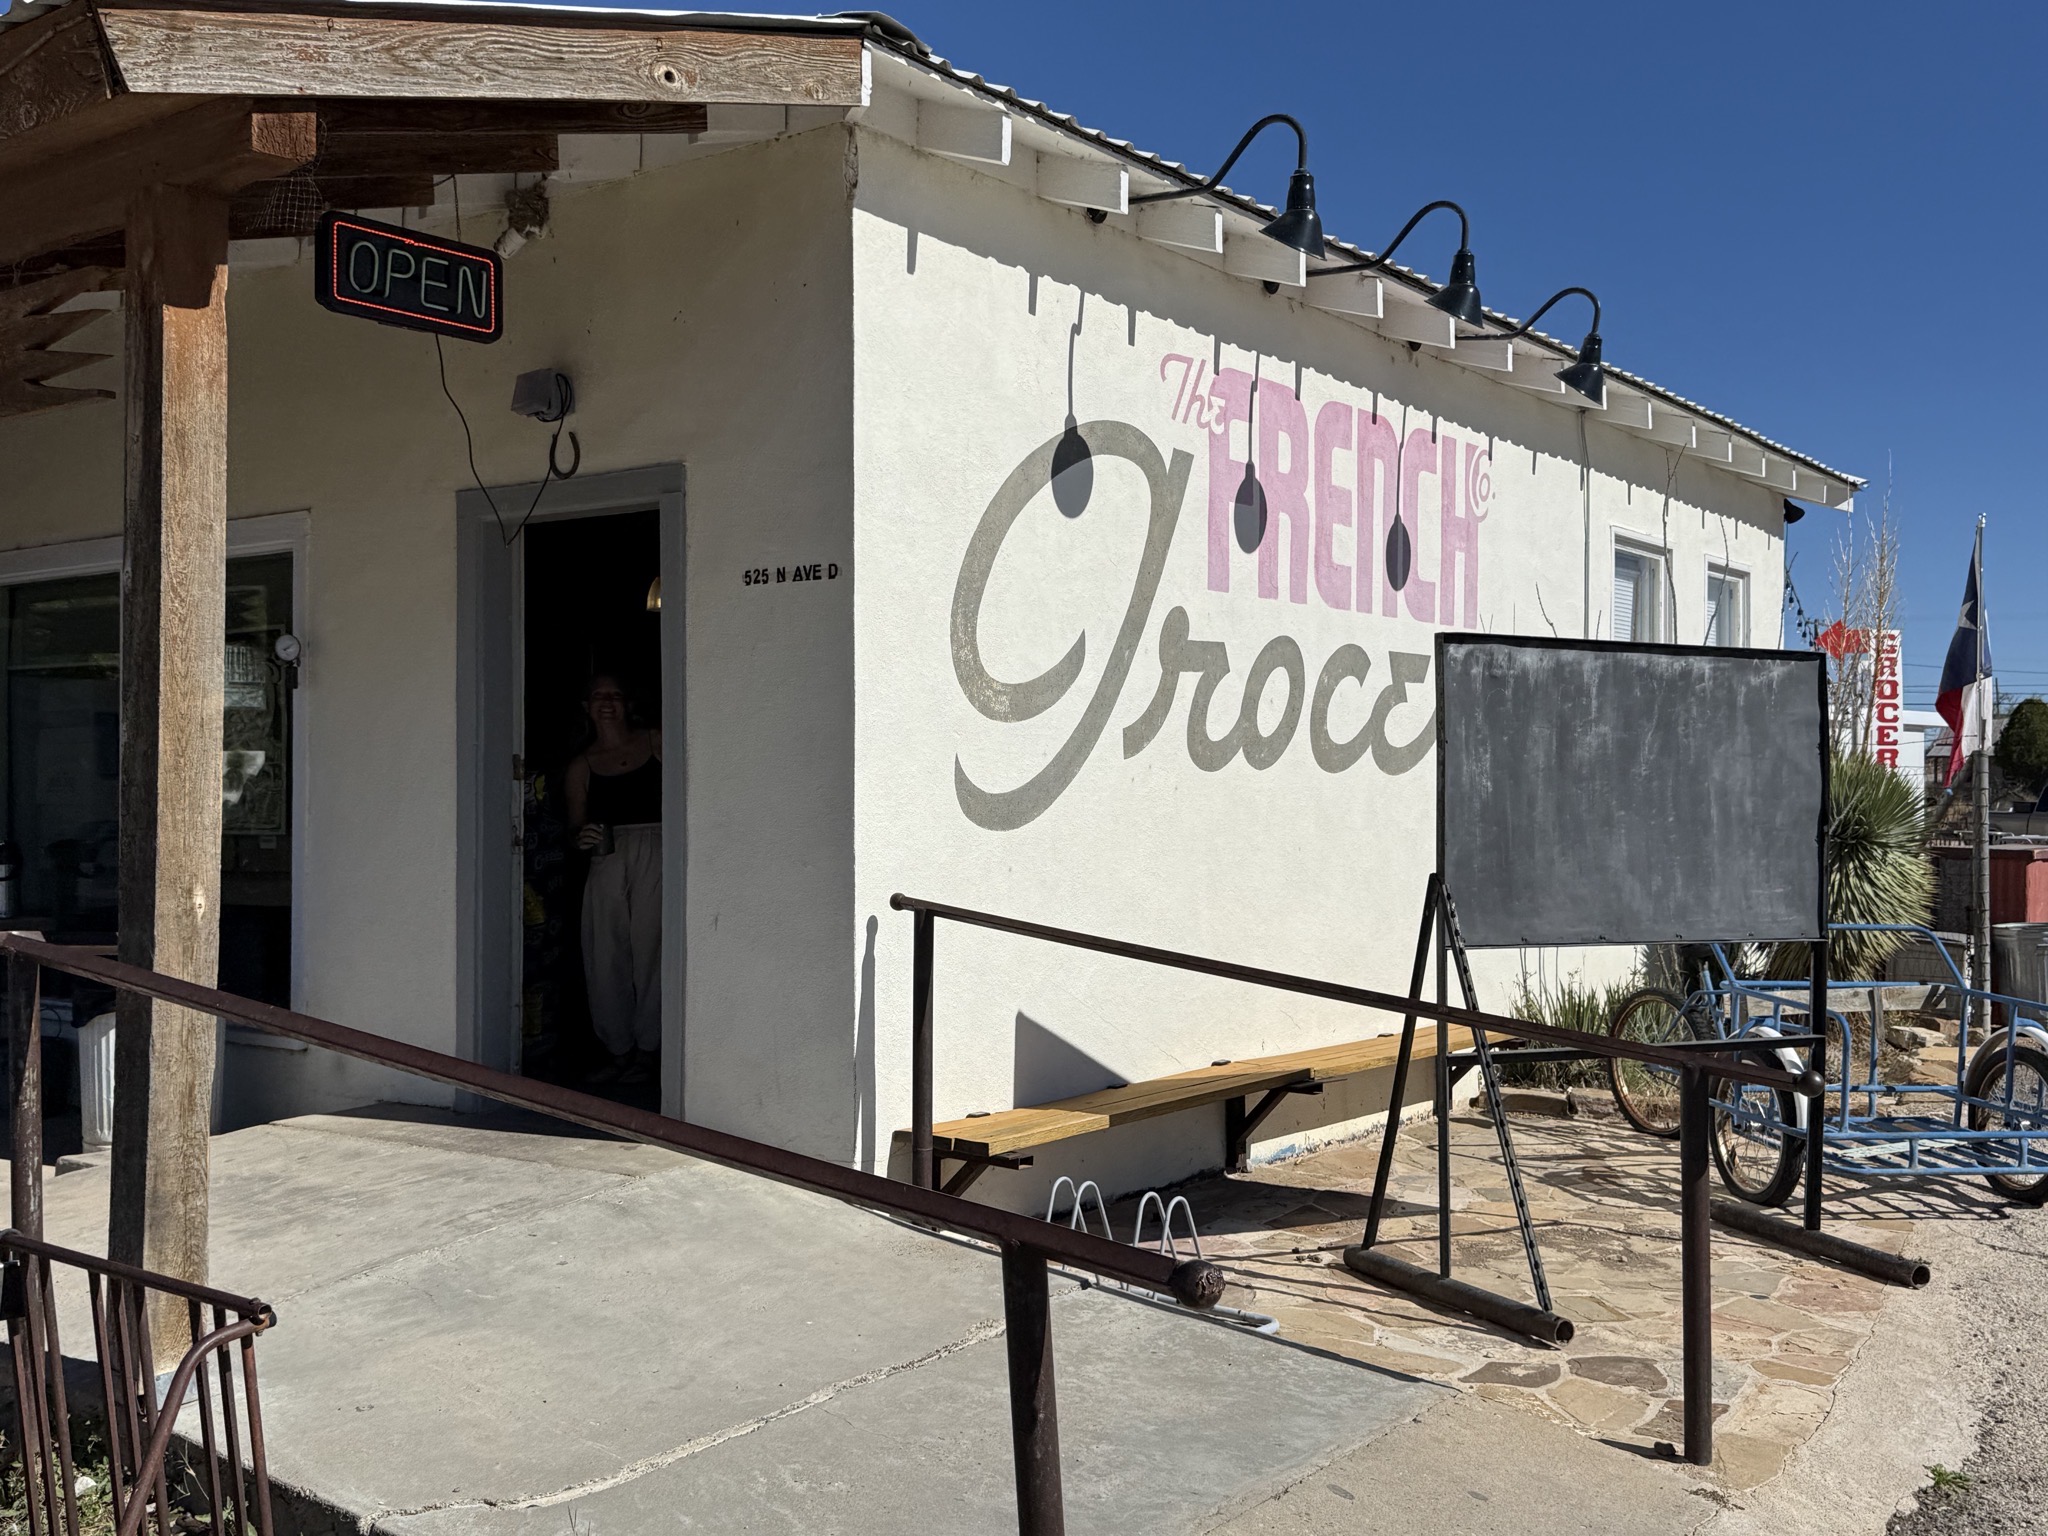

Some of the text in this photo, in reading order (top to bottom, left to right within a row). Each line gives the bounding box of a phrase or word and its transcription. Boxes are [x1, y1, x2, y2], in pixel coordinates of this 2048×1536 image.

[349, 240, 488, 320] OPEN
[1160, 352, 1226, 435] The
[1207, 366, 1479, 630] FRENCH
[744, 563, 838, 586] 525 N AVE D
